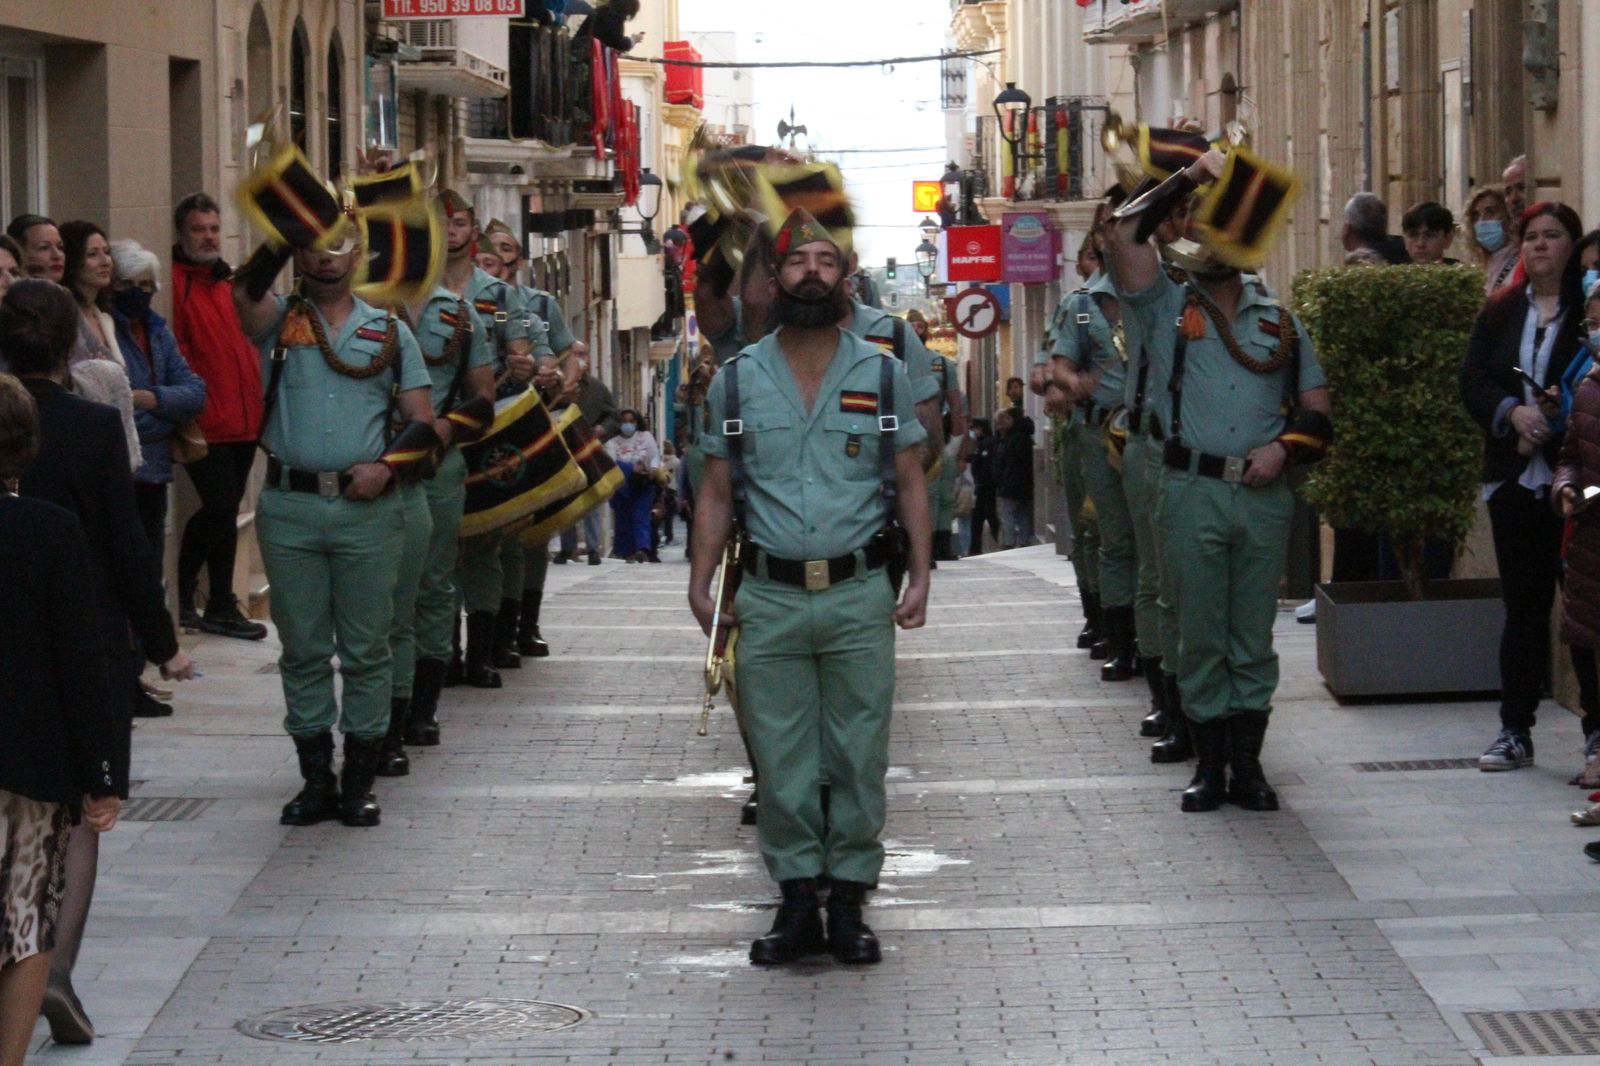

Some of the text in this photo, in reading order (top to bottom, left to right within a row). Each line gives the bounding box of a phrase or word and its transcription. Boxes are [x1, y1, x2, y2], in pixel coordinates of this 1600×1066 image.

[420, 0, 448, 13] 950
[451, 0, 470, 12] 39
[474, 0, 493, 12] 08
[497, 0, 516, 12] 03
[952, 255, 996, 264] MAPFRE
